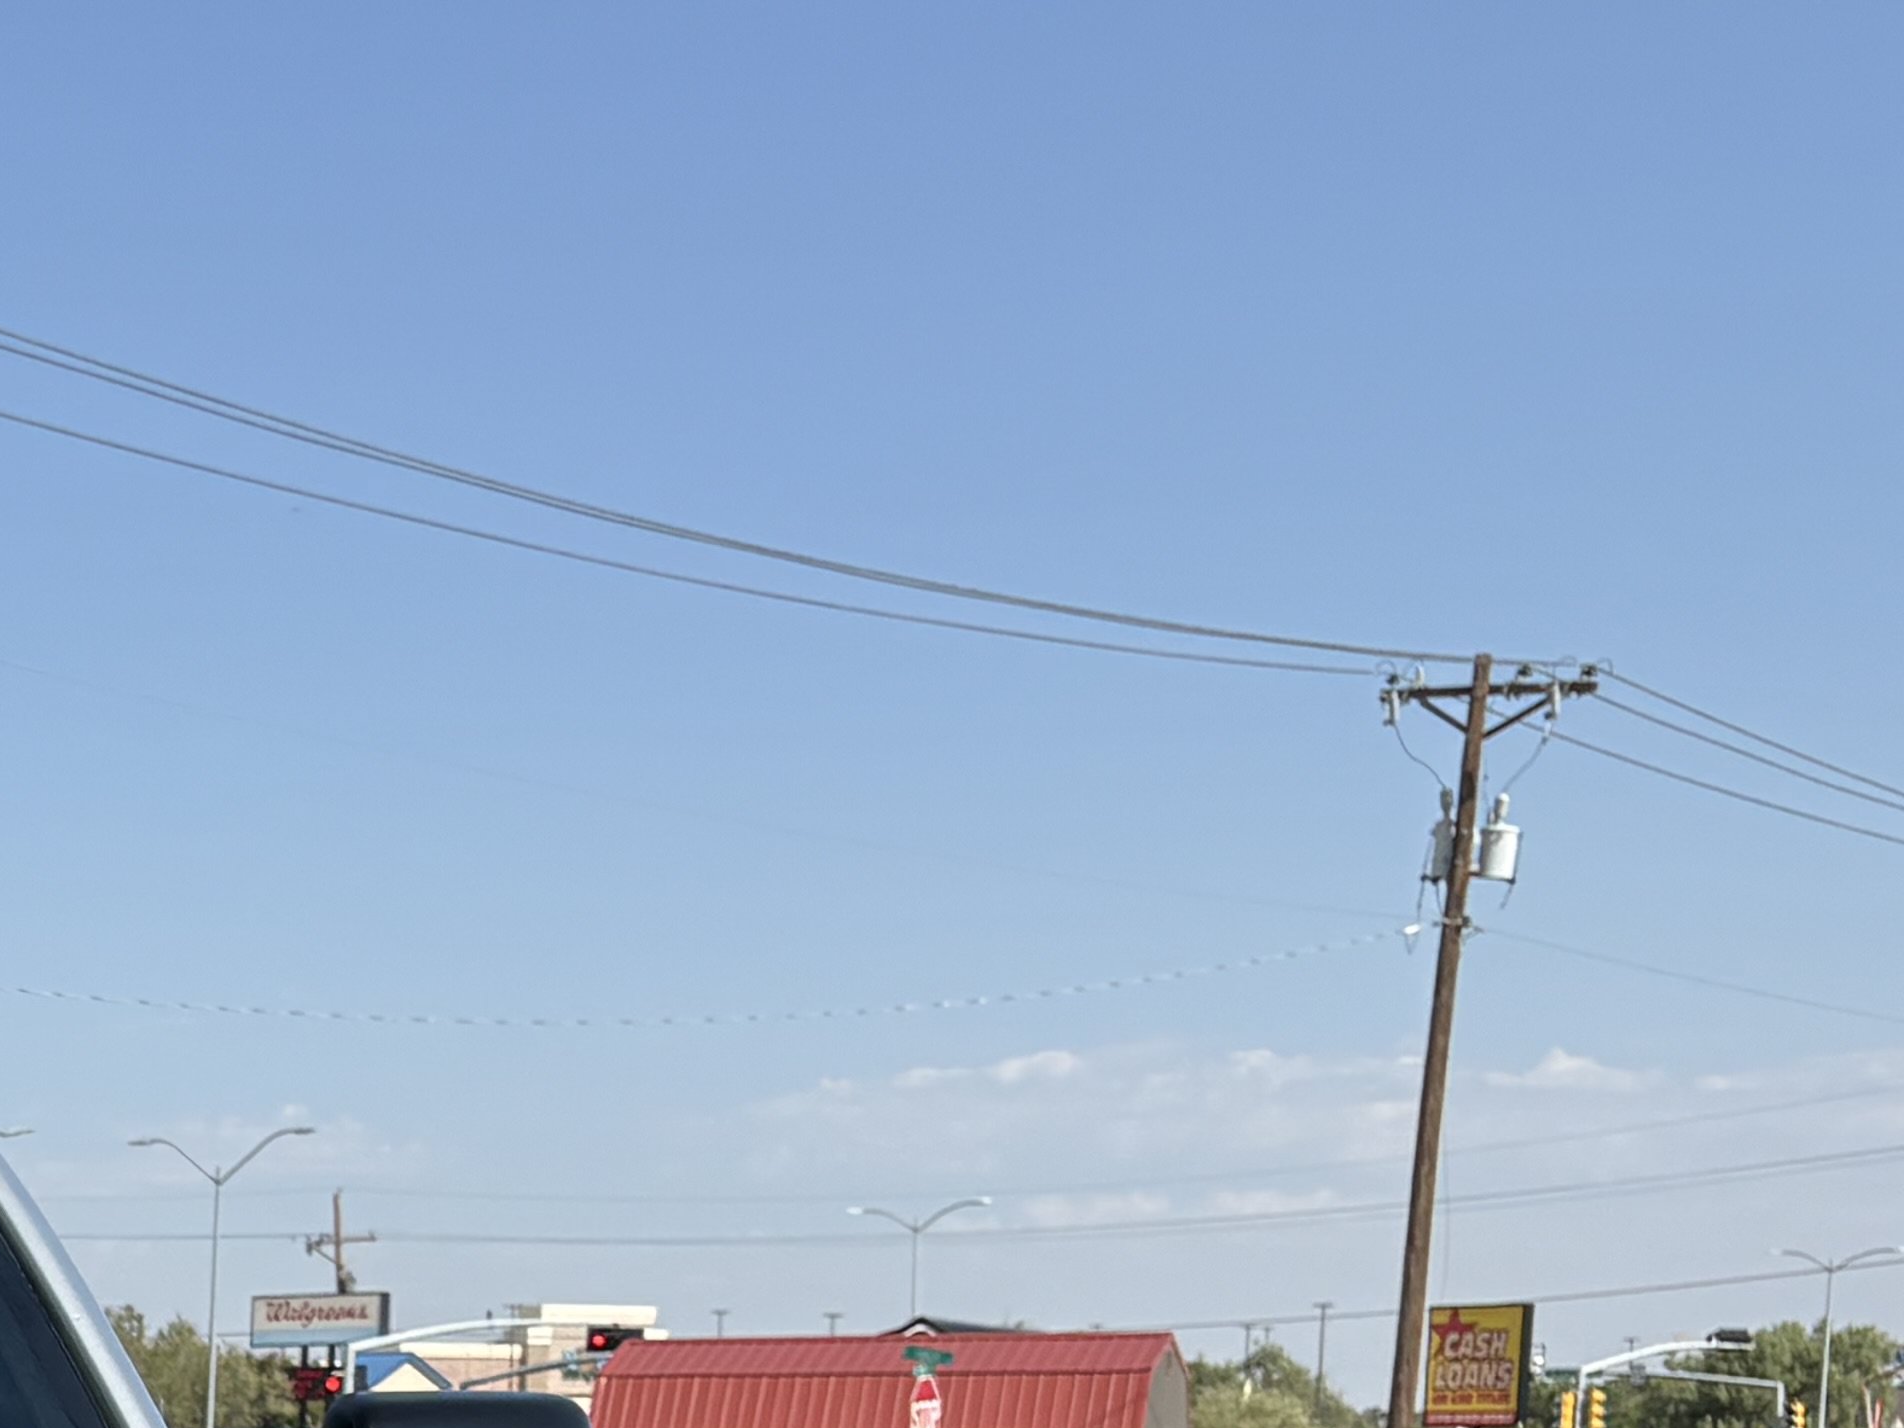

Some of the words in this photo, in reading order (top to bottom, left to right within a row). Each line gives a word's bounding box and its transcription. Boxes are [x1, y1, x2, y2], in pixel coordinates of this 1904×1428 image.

[266, 1300, 369, 1328] Walgreens
[1443, 1330, 1508, 1359] CASH
[1435, 1360, 1513, 1391] LOANS
